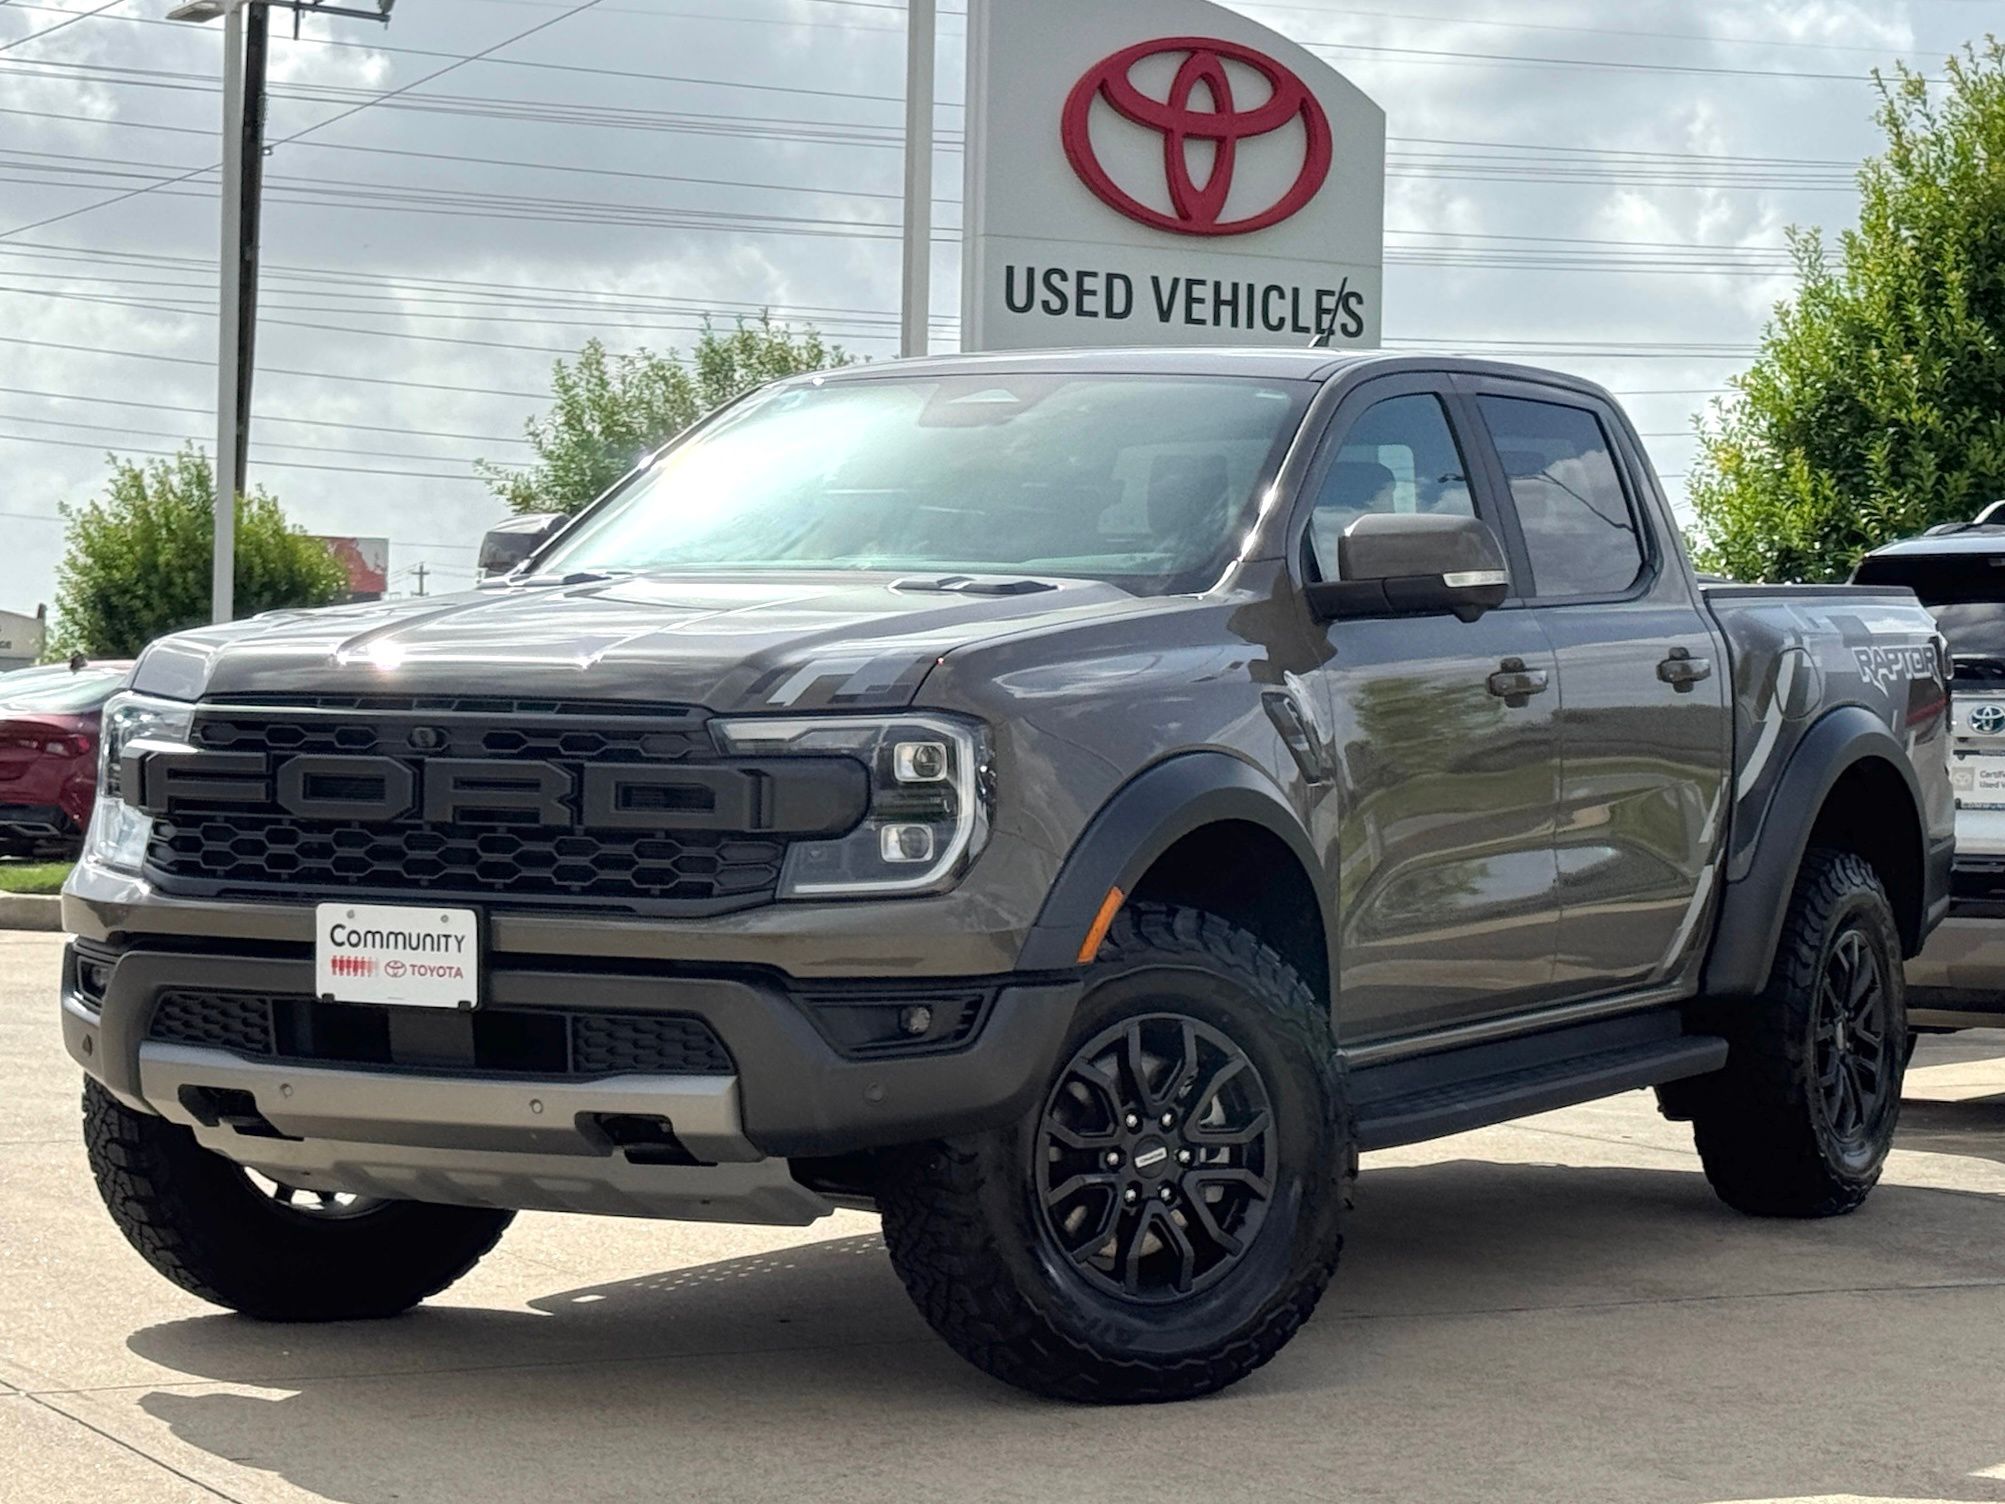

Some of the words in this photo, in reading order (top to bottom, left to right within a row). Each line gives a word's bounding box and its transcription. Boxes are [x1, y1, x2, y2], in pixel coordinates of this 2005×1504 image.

[1005, 265, 1133, 320] USED
[1150, 275, 1364, 338] VEHICLES
[1851, 644, 1945, 698] RAPTOR
[145, 752, 752, 832] FORD
[410, 963, 464, 979] TOYOTA
